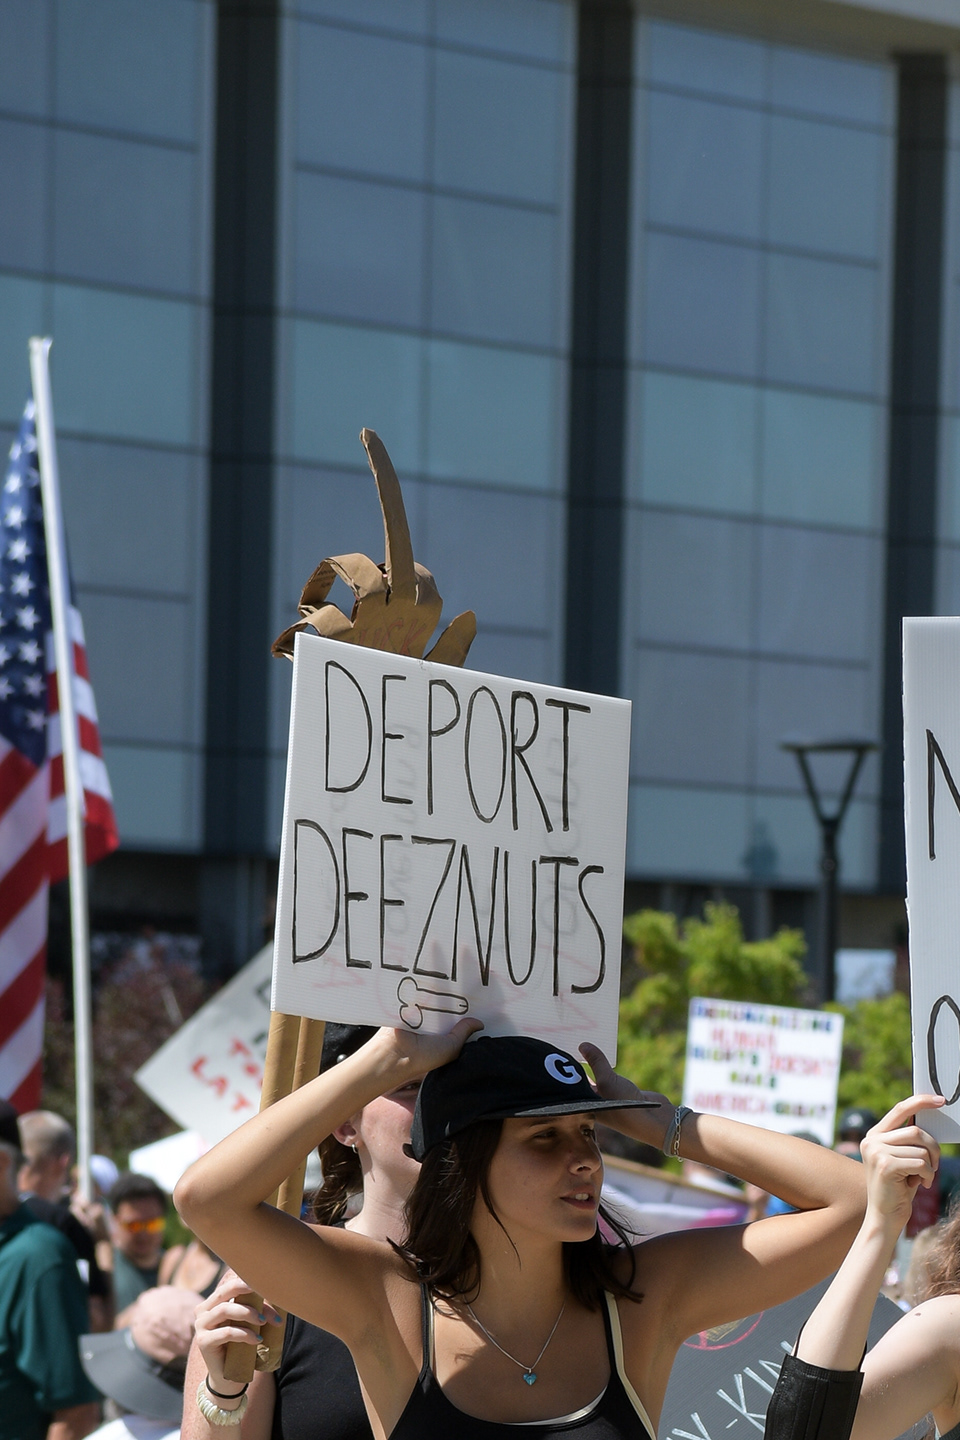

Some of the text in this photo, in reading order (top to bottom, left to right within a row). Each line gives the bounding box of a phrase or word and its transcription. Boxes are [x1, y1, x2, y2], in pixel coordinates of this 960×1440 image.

[349, 618, 427, 657] UCK
[324, 659, 592, 834] DEPORT
[544, 1053, 583, 1085] G
